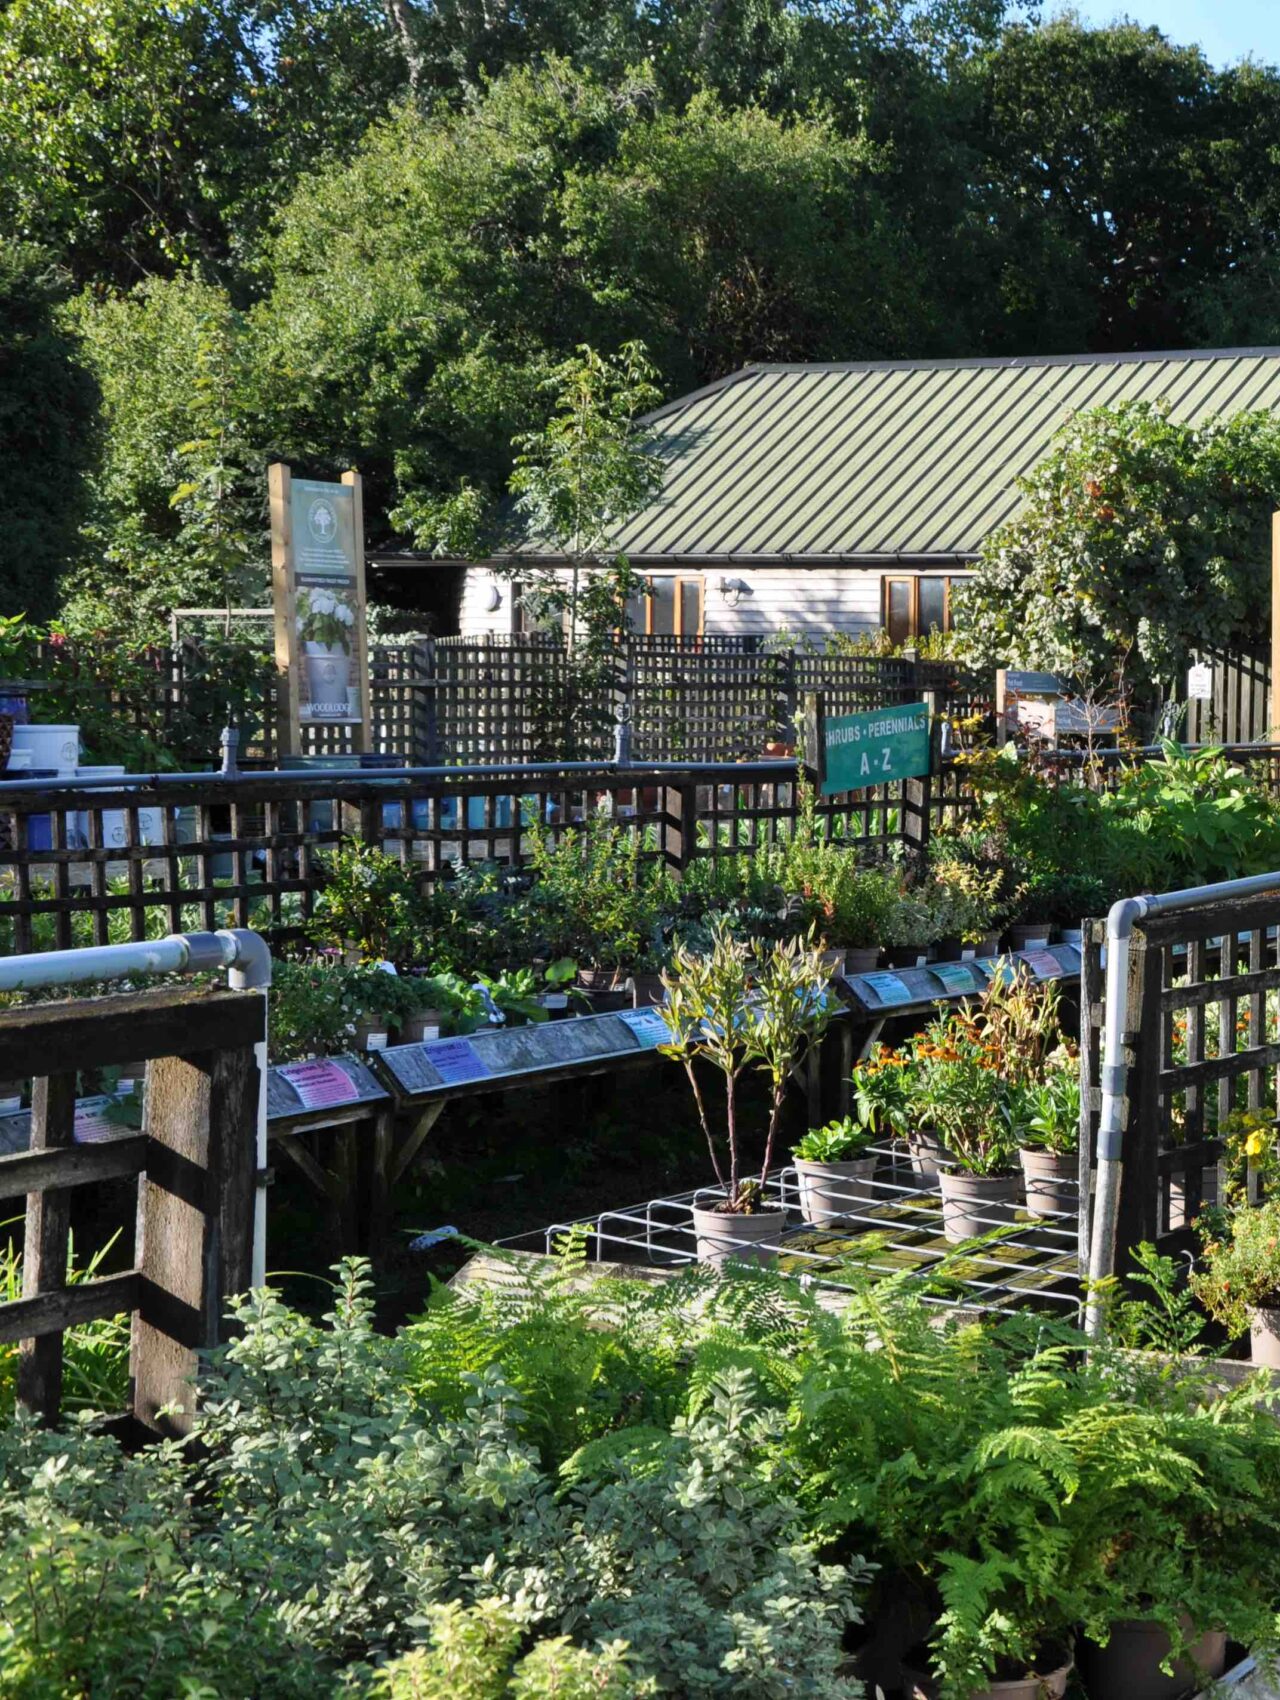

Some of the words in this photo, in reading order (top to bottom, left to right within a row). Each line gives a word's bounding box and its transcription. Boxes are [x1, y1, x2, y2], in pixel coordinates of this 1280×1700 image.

[868, 715, 926, 739] PERENNIALS
[860, 752, 870, 776] A
[881, 747, 892, 772] Z
